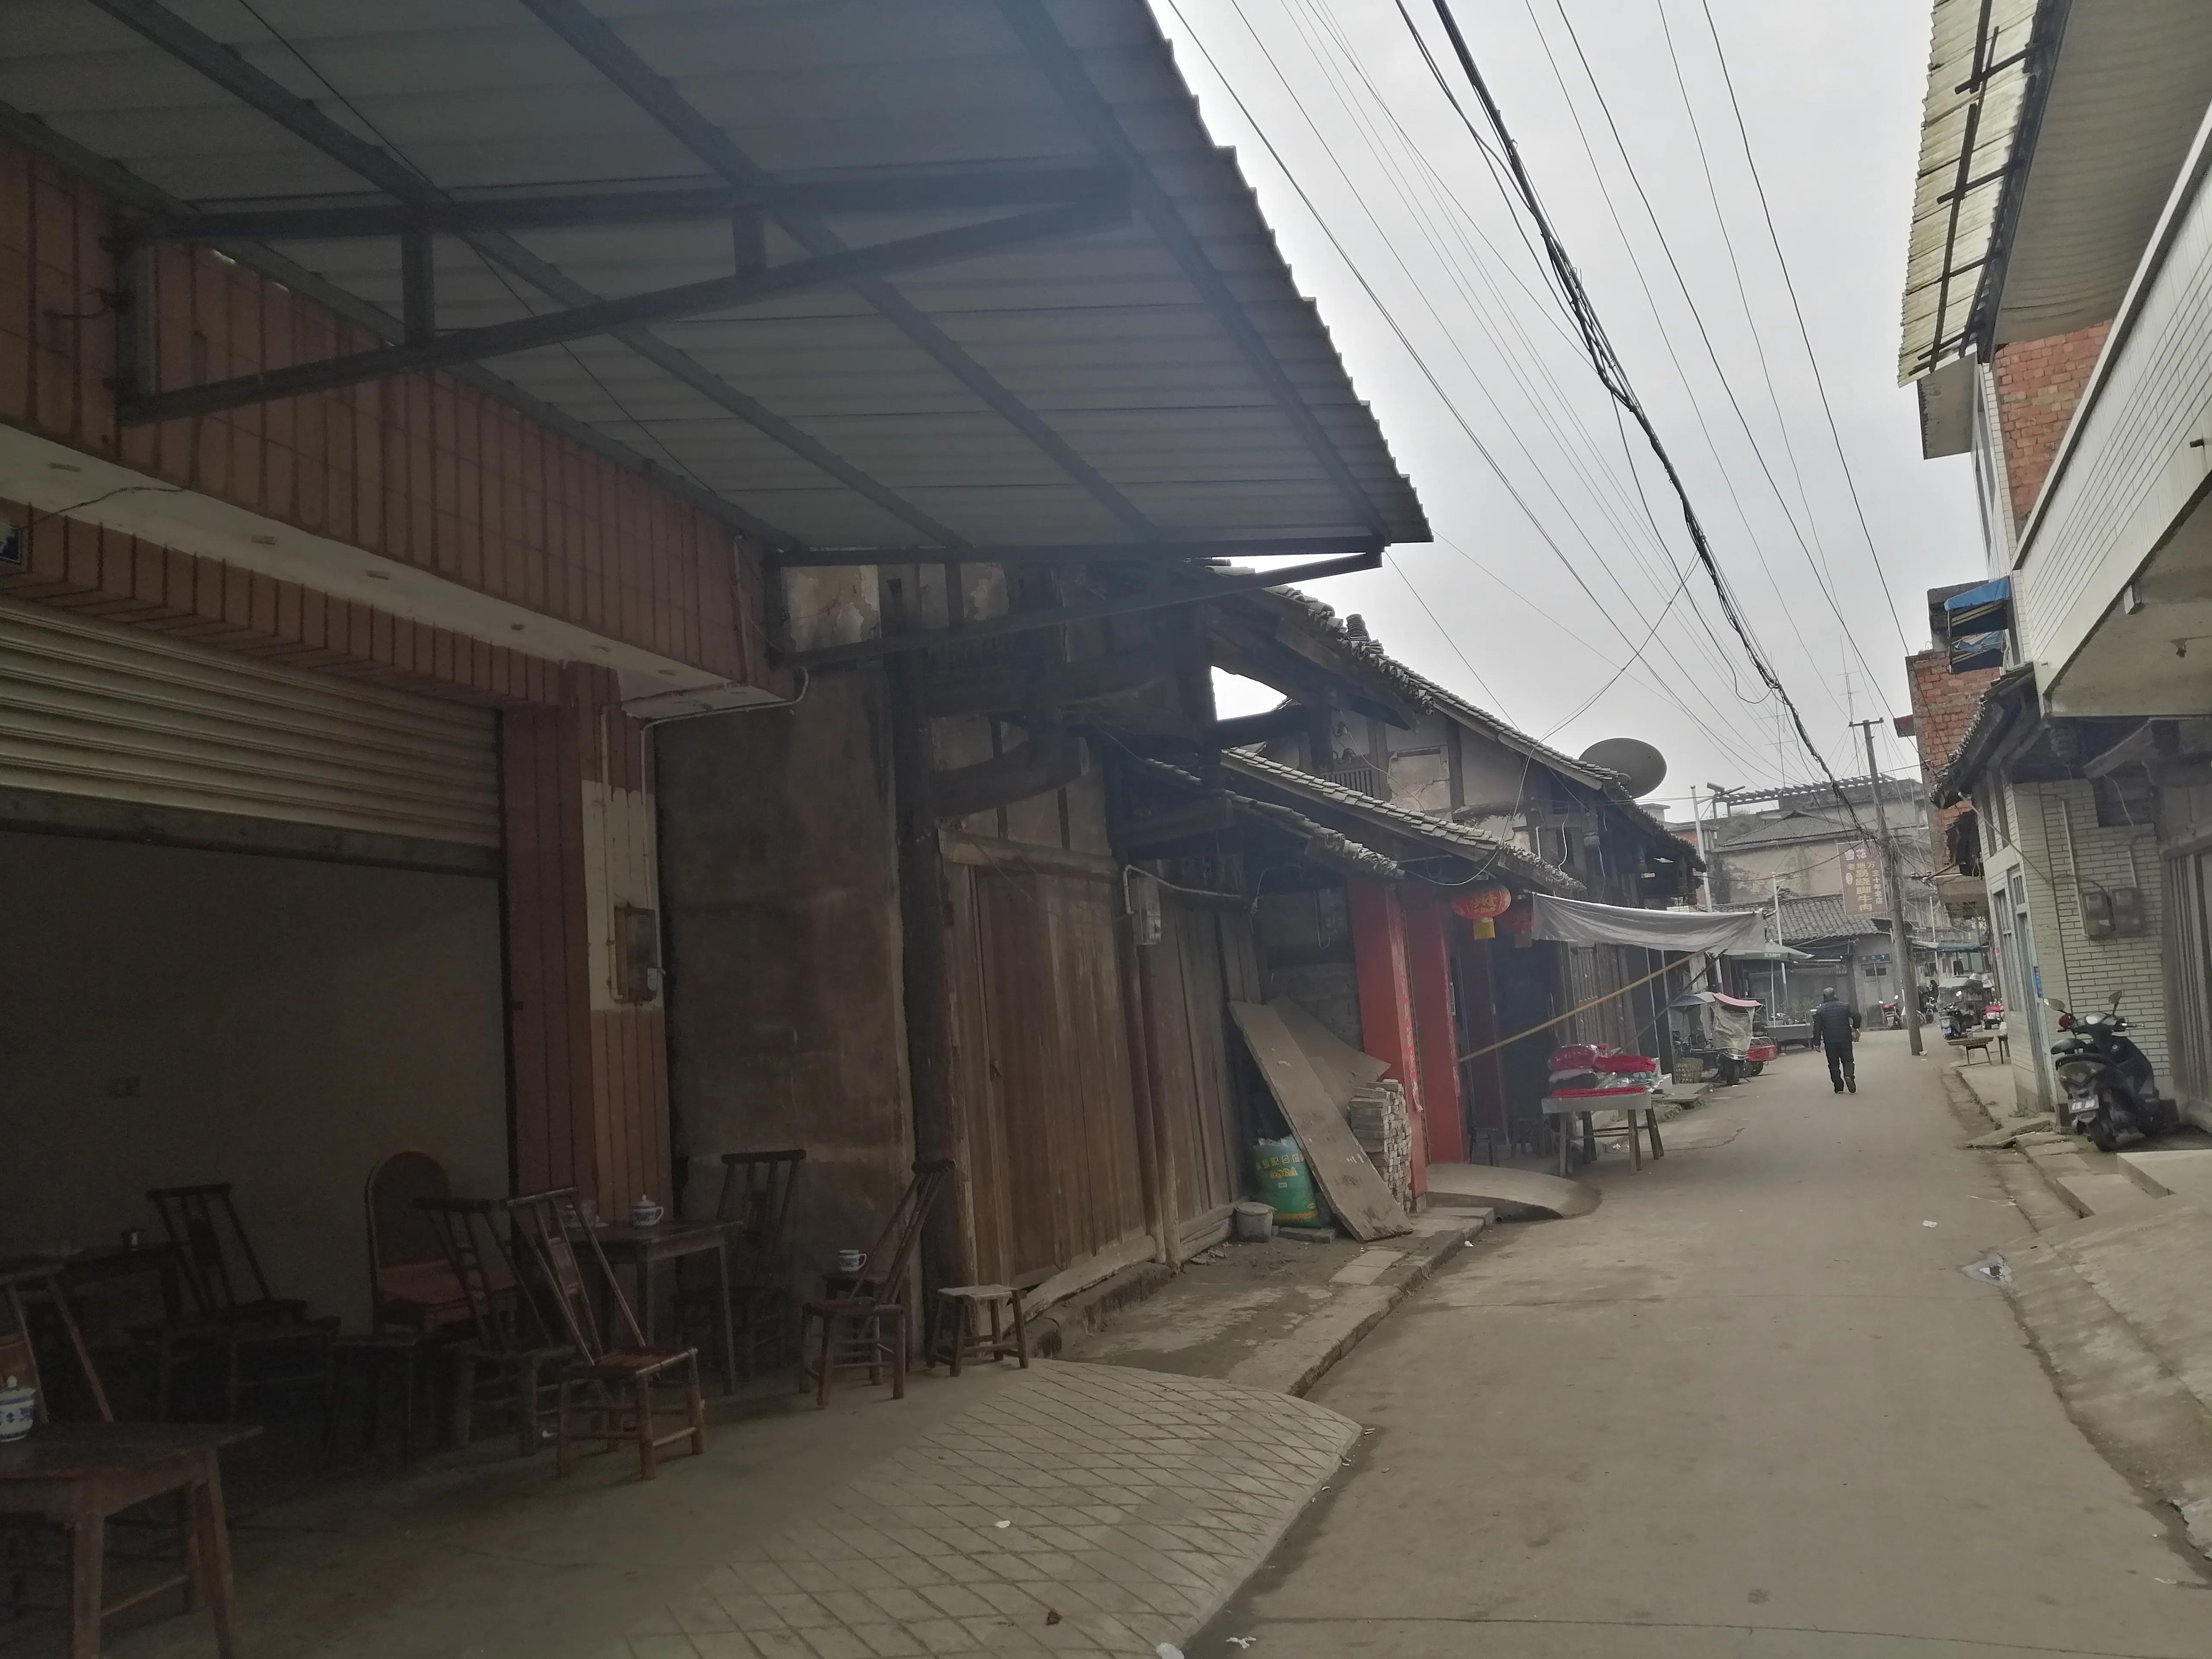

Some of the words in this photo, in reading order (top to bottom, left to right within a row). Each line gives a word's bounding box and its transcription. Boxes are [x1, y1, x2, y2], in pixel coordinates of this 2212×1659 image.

[1844, 849, 1867, 860] 雪花
[1847, 861, 1875, 870] 老地方
[1872, 870, 1883, 904] 三十年老店
